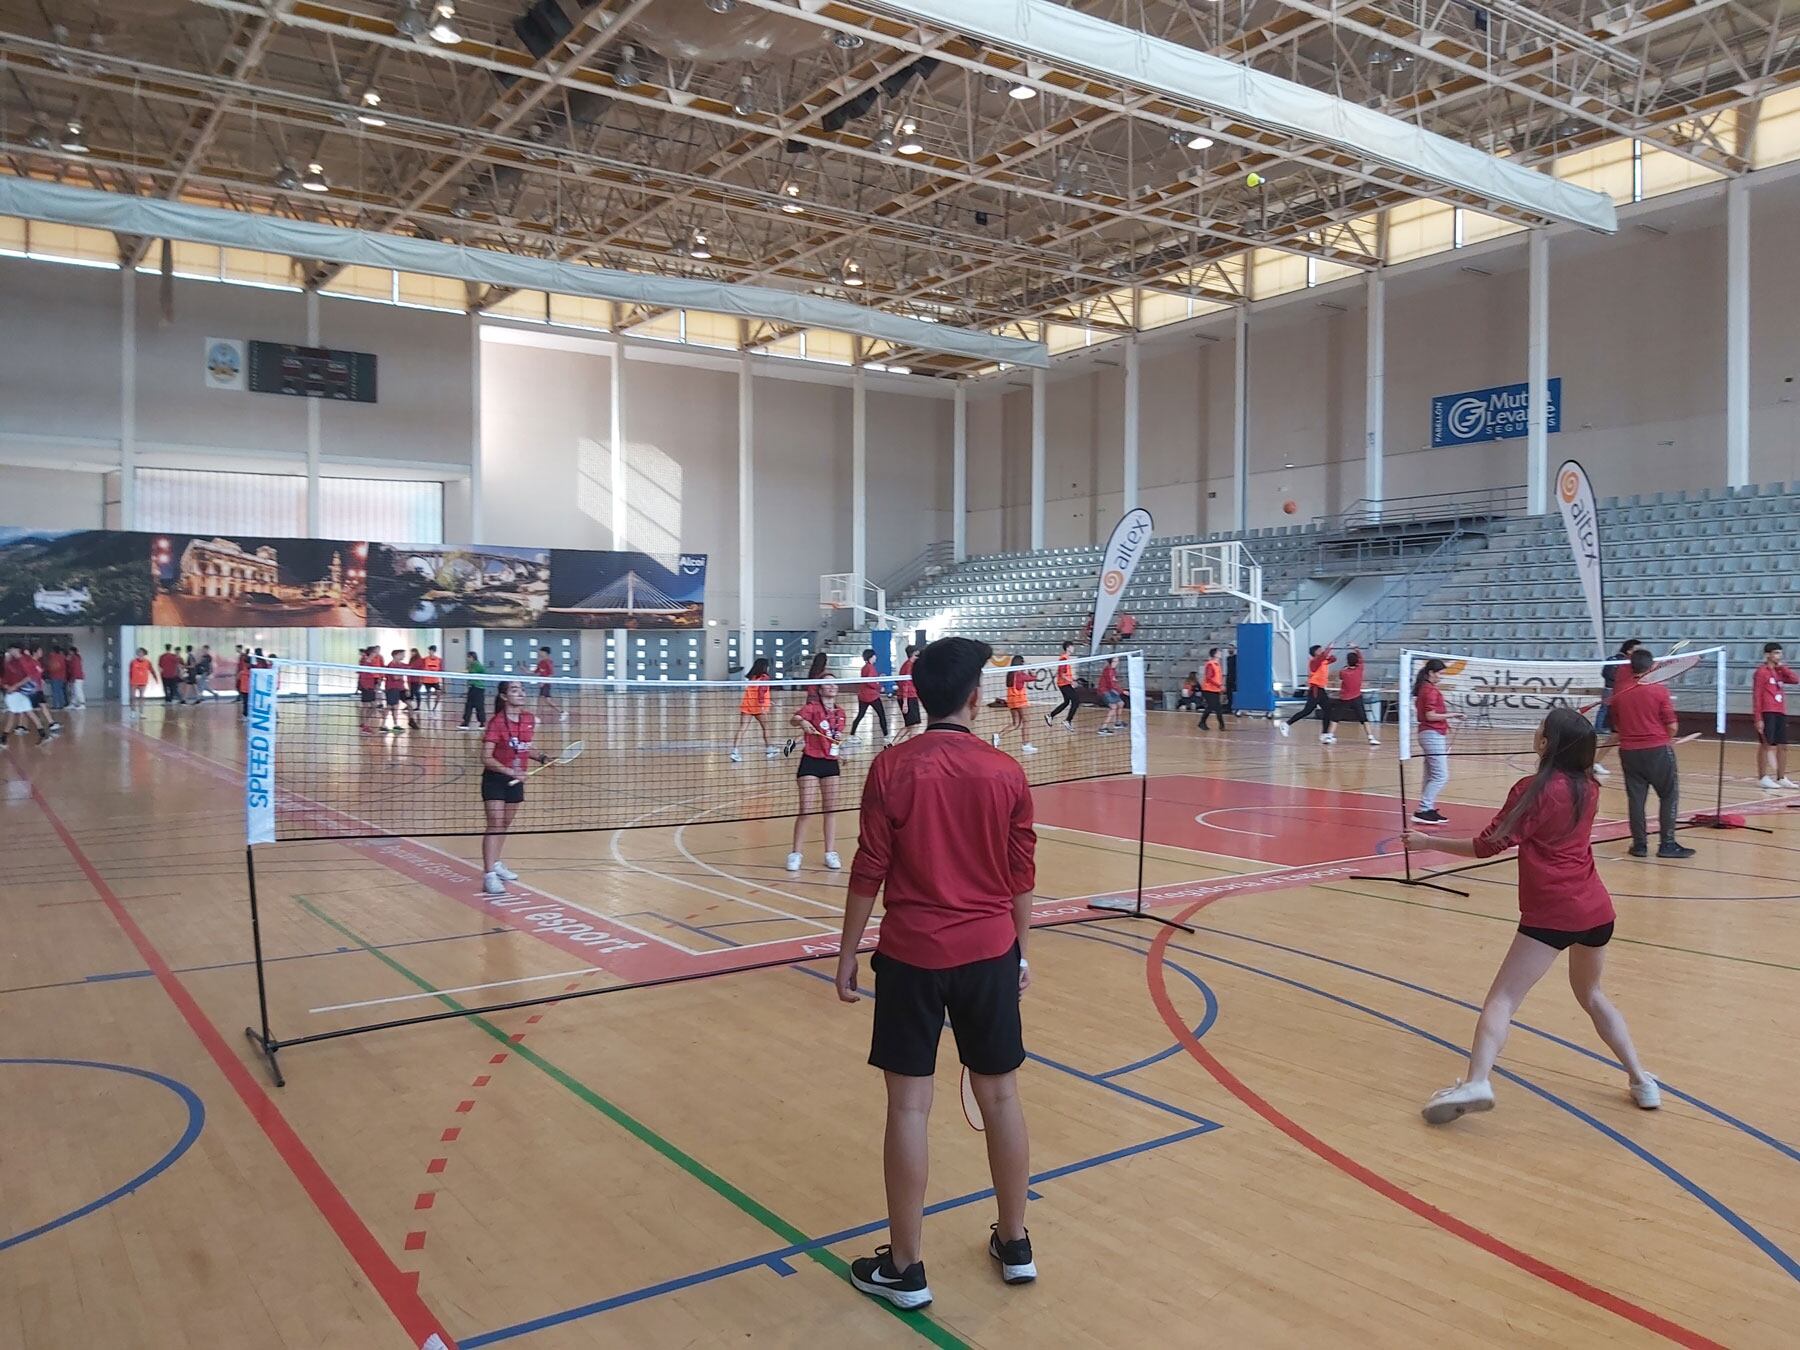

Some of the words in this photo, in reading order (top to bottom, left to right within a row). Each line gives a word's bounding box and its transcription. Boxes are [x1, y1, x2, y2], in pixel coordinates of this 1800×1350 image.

[1487, 405, 1555, 425] Levae
[1489, 390, 1552, 411] Mut
[1486, 418, 1555, 435] SEGUS
[251, 673, 271, 732] NET
[249, 736, 269, 808] SPEED
[511, 904, 648, 953] l'esport
